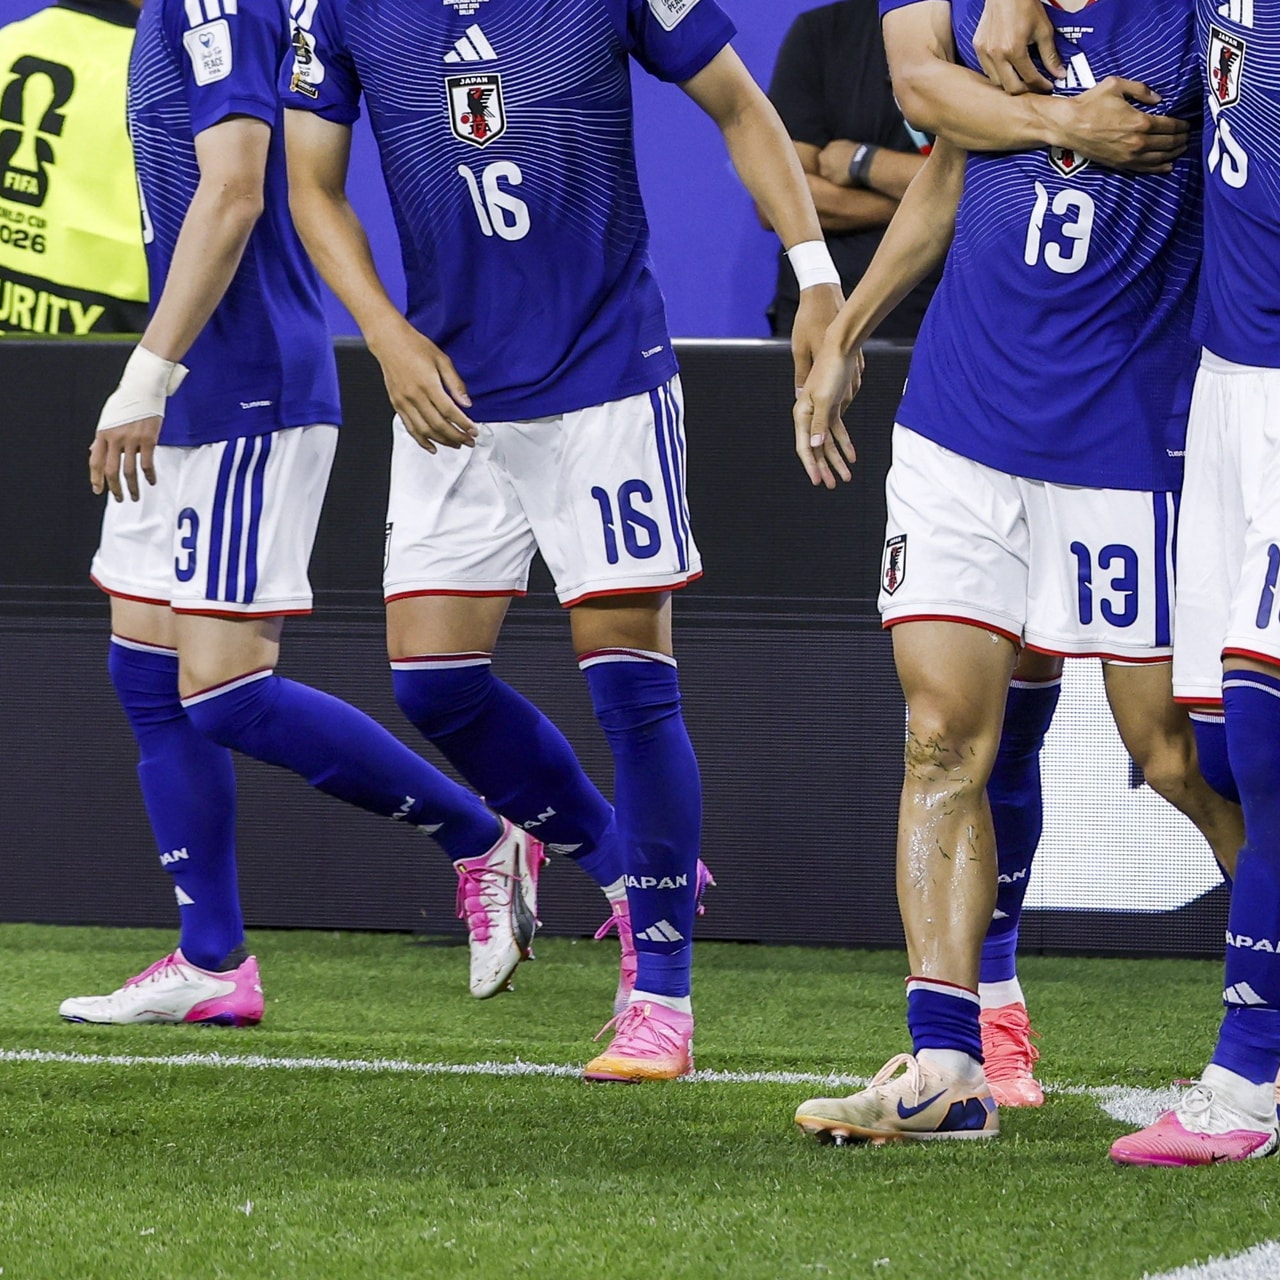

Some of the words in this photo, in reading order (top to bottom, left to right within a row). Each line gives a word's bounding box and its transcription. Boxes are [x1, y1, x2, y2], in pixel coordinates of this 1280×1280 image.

[1218, 32, 1238, 47] JAPAN
[459, 76, 489, 86] JAPAN
[3, 170, 40, 196] FIFA
[458, 161, 531, 241] 16
[1024, 181, 1095, 274] 13
[174, 507, 199, 583] 3
[591, 478, 662, 565] 16
[1070, 540, 1138, 628] 13
